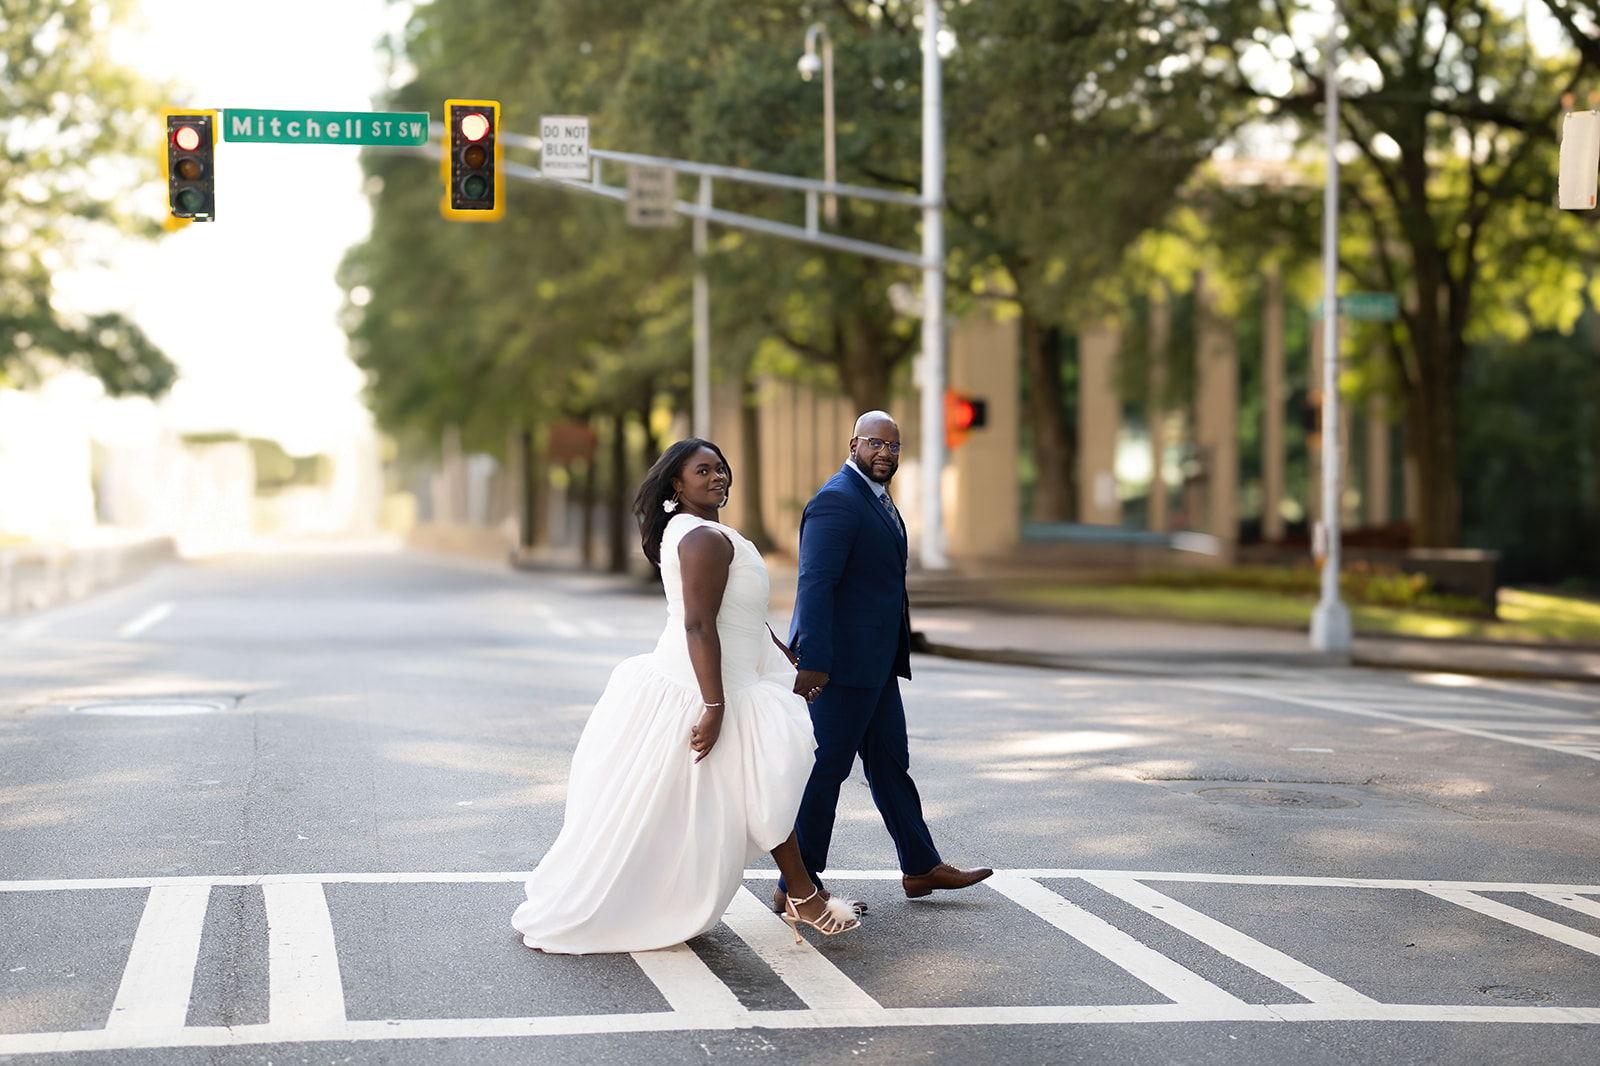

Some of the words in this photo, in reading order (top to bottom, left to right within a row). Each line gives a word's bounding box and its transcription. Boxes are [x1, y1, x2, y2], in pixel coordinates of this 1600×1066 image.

[232, 116, 362, 138] Mitchell
[371, 121, 393, 137] ST
[398, 122, 421, 138] SW
[543, 125, 560, 138] DO
[564, 126, 587, 139] NOT
[546, 143, 584, 156] BLOCK
